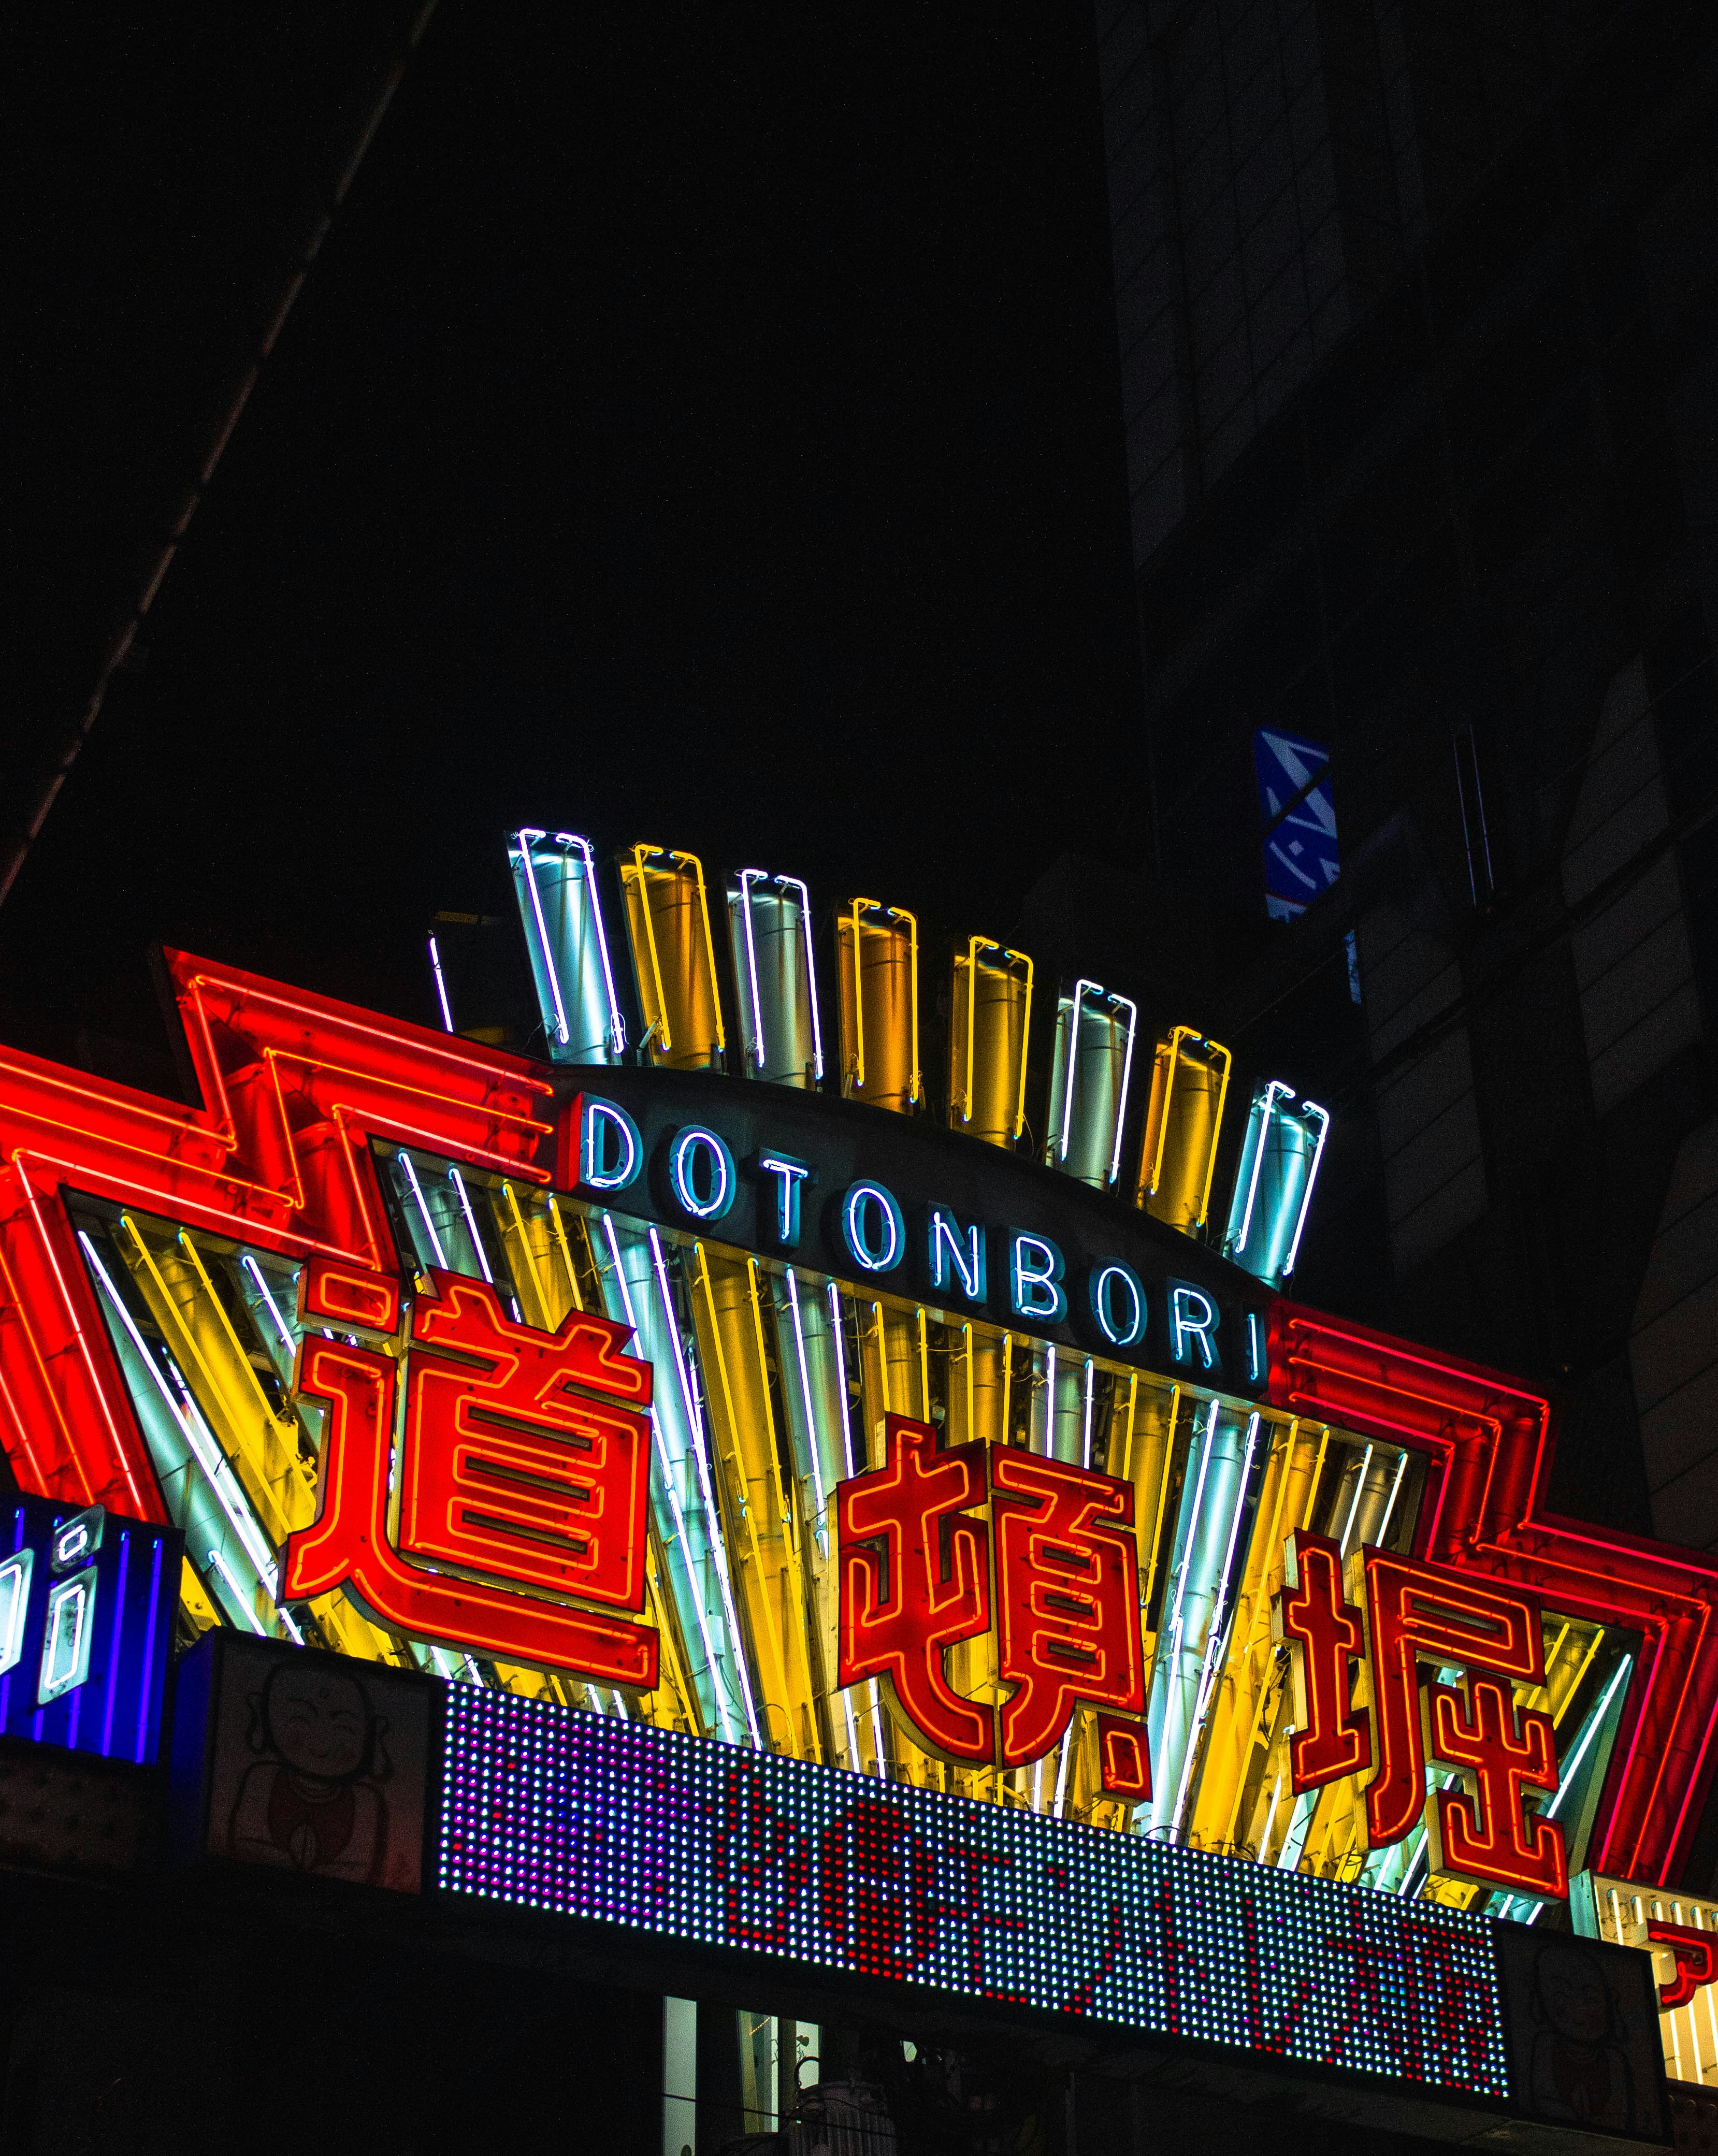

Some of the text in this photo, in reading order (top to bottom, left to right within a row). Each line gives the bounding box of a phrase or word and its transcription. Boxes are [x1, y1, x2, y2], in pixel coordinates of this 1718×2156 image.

[580, 1090, 1267, 1388] DOTONBORI
[277, 1255, 1569, 1900] 道頓堀
